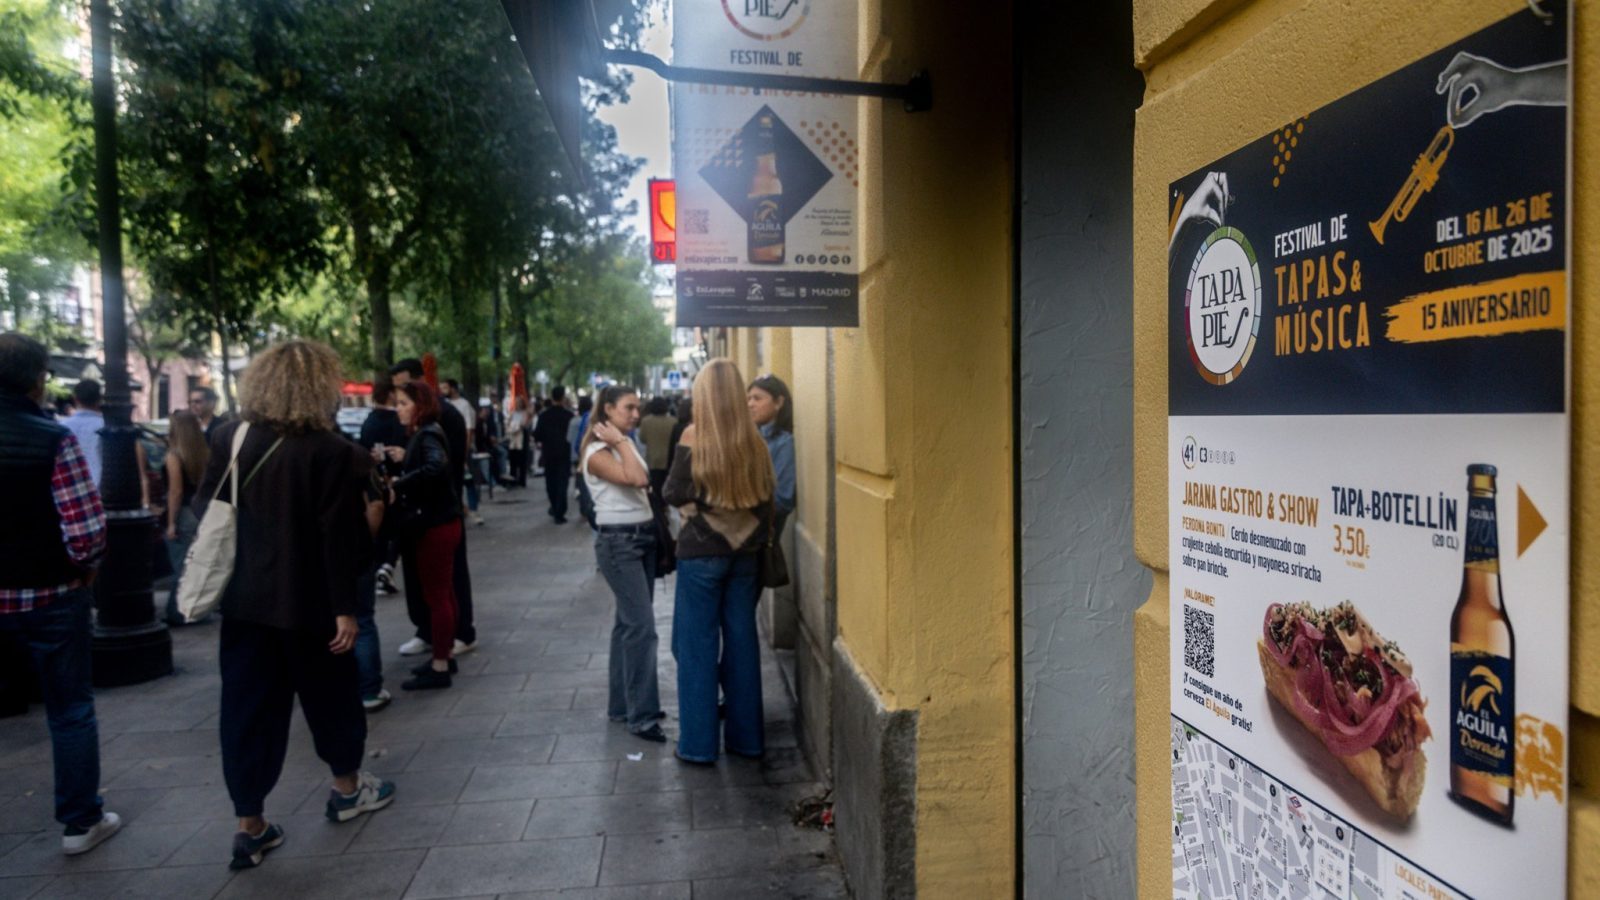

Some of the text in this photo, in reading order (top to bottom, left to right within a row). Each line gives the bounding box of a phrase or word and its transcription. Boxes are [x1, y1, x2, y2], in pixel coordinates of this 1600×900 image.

[730, 50, 803, 66] FESTIVAL DE
[1275, 213, 1348, 258] FESTIVAL DE
[1436, 192, 1552, 243] DEL 16 AL 26 DE
[1424, 224, 1553, 273] OCTUBRE DE 2025
[811, 288, 851, 297] MADRID
[1198, 266, 1246, 309] TAPA
[1422, 286, 1550, 330] 15 ANIVERSARIO
[1275, 302, 1370, 356] MÚSICA
[1184, 444, 1194, 462] 41
[1182, 481, 1319, 528] JARANA GASTRO & SHOW
[1182, 516, 1306, 556] PERDONA BONITA Cerdo desmenuzado con
[1182, 536, 1322, 582] crujiente cebolla encurtida y mayonesa sriracha
[1182, 553, 1229, 578] sobre pan brioche.
[1184, 688, 1204, 706] cerveza
[1231, 714, 1252, 733] gratis!
[1189, 676, 1213, 696] consigue
[1214, 689, 1222, 701] un
[1223, 693, 1234, 707] año
[1235, 698, 1243, 711] de
